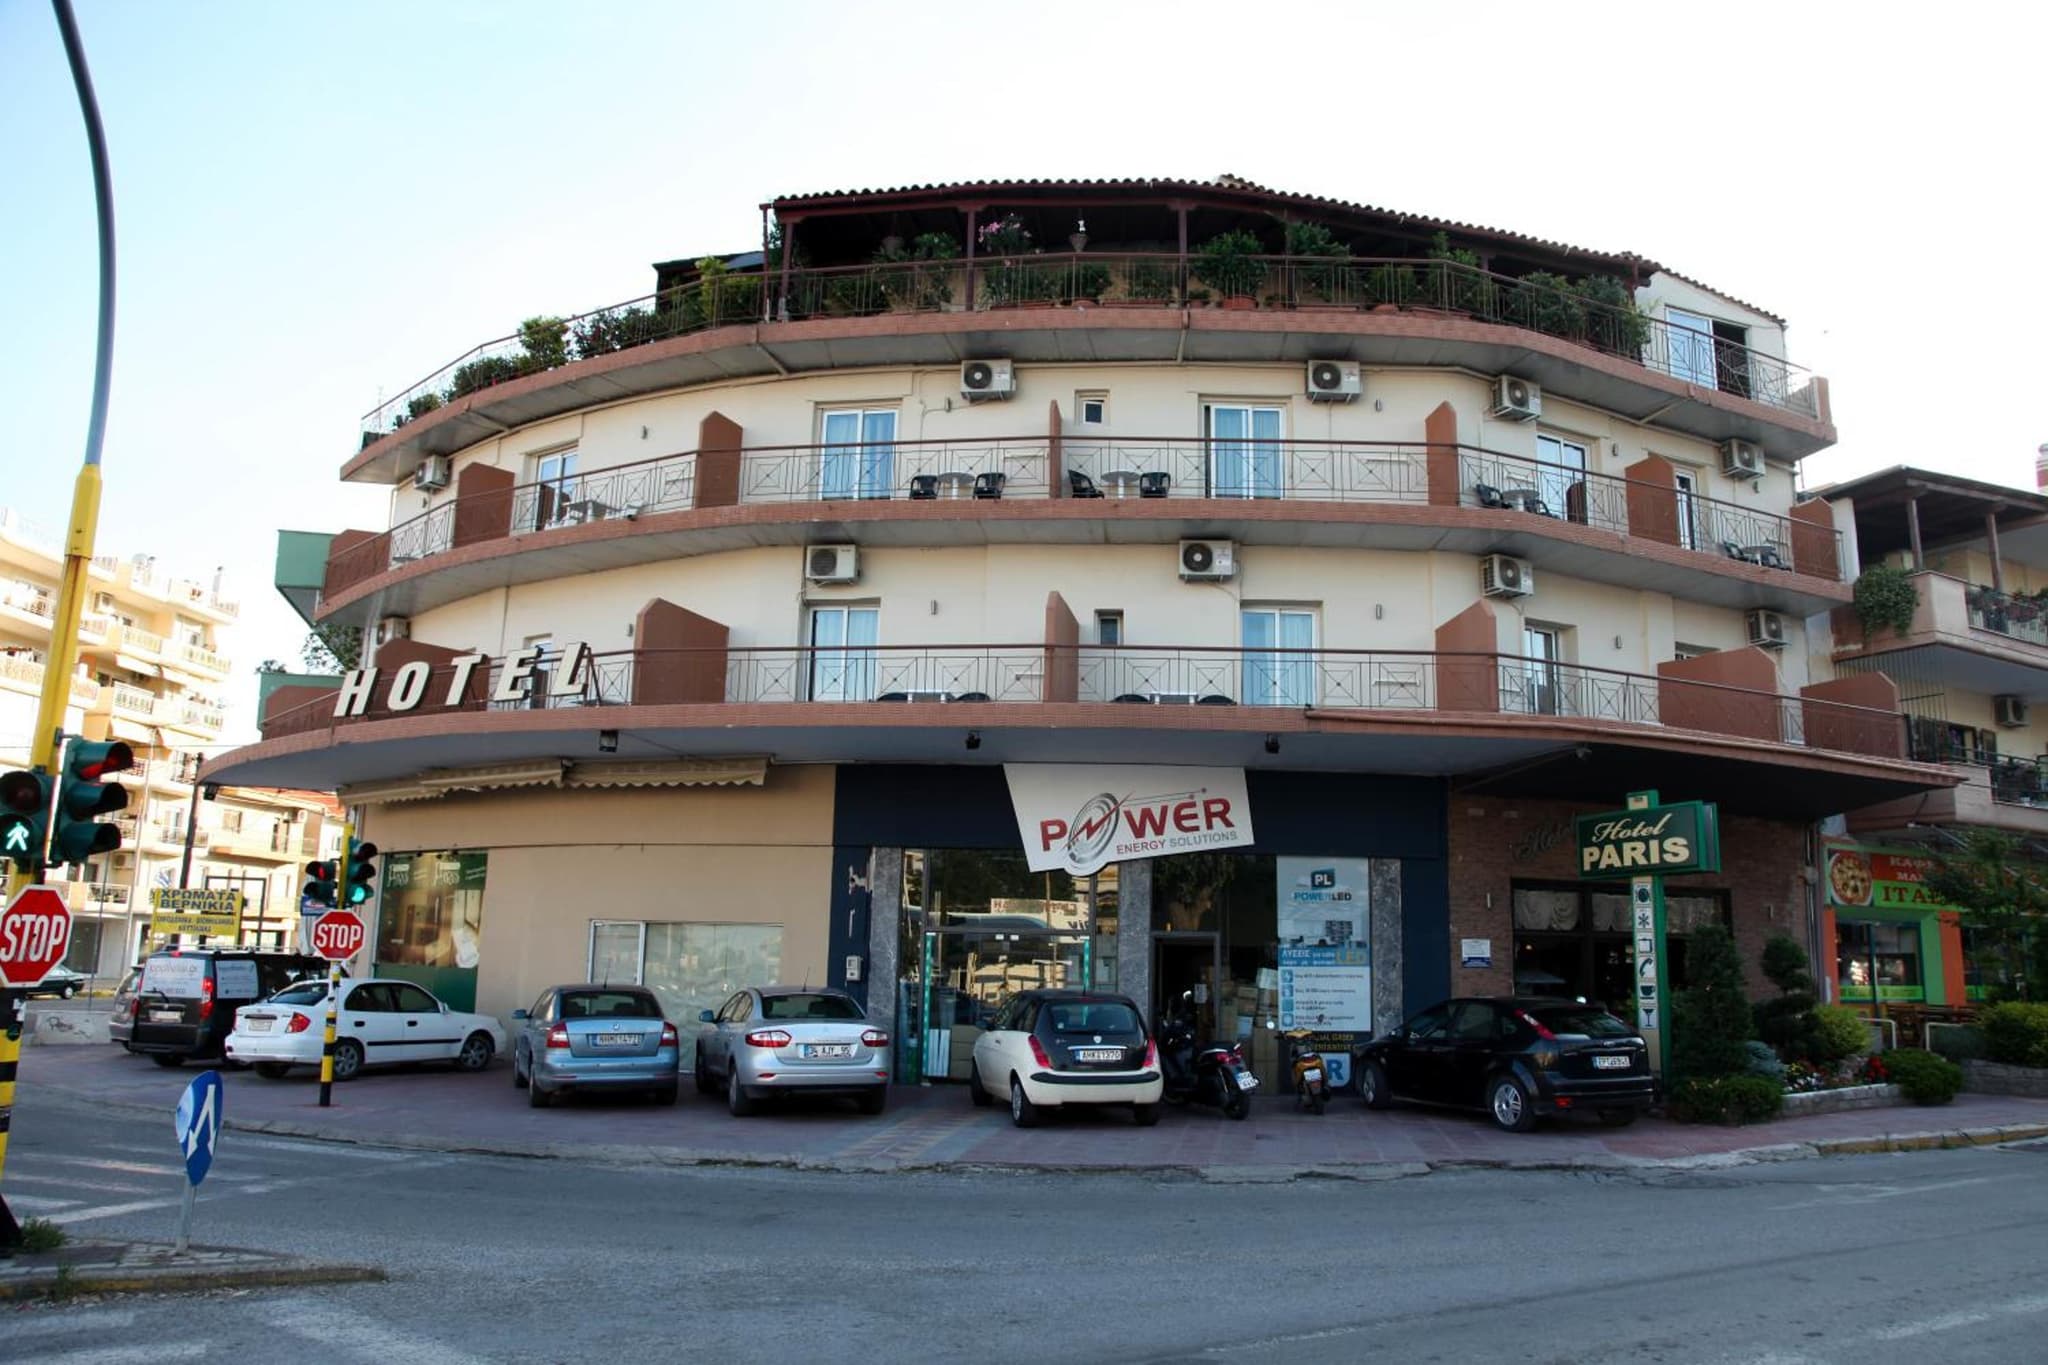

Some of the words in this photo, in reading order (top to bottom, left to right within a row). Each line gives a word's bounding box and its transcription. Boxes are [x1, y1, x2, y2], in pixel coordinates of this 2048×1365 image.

[332, 641, 590, 718] HOTEL
[1039, 793, 1236, 863] POWER
[1116, 838, 1167, 855] ENERGY
[1168, 830, 1239, 849] SOLUTIONS
[1592, 812, 1673, 843] Hotel
[1583, 836, 1691, 872] PARIS
[1313, 873, 1333, 887] PL
[0, 913, 67, 963] STOP
[315, 922, 362, 950] STOP
